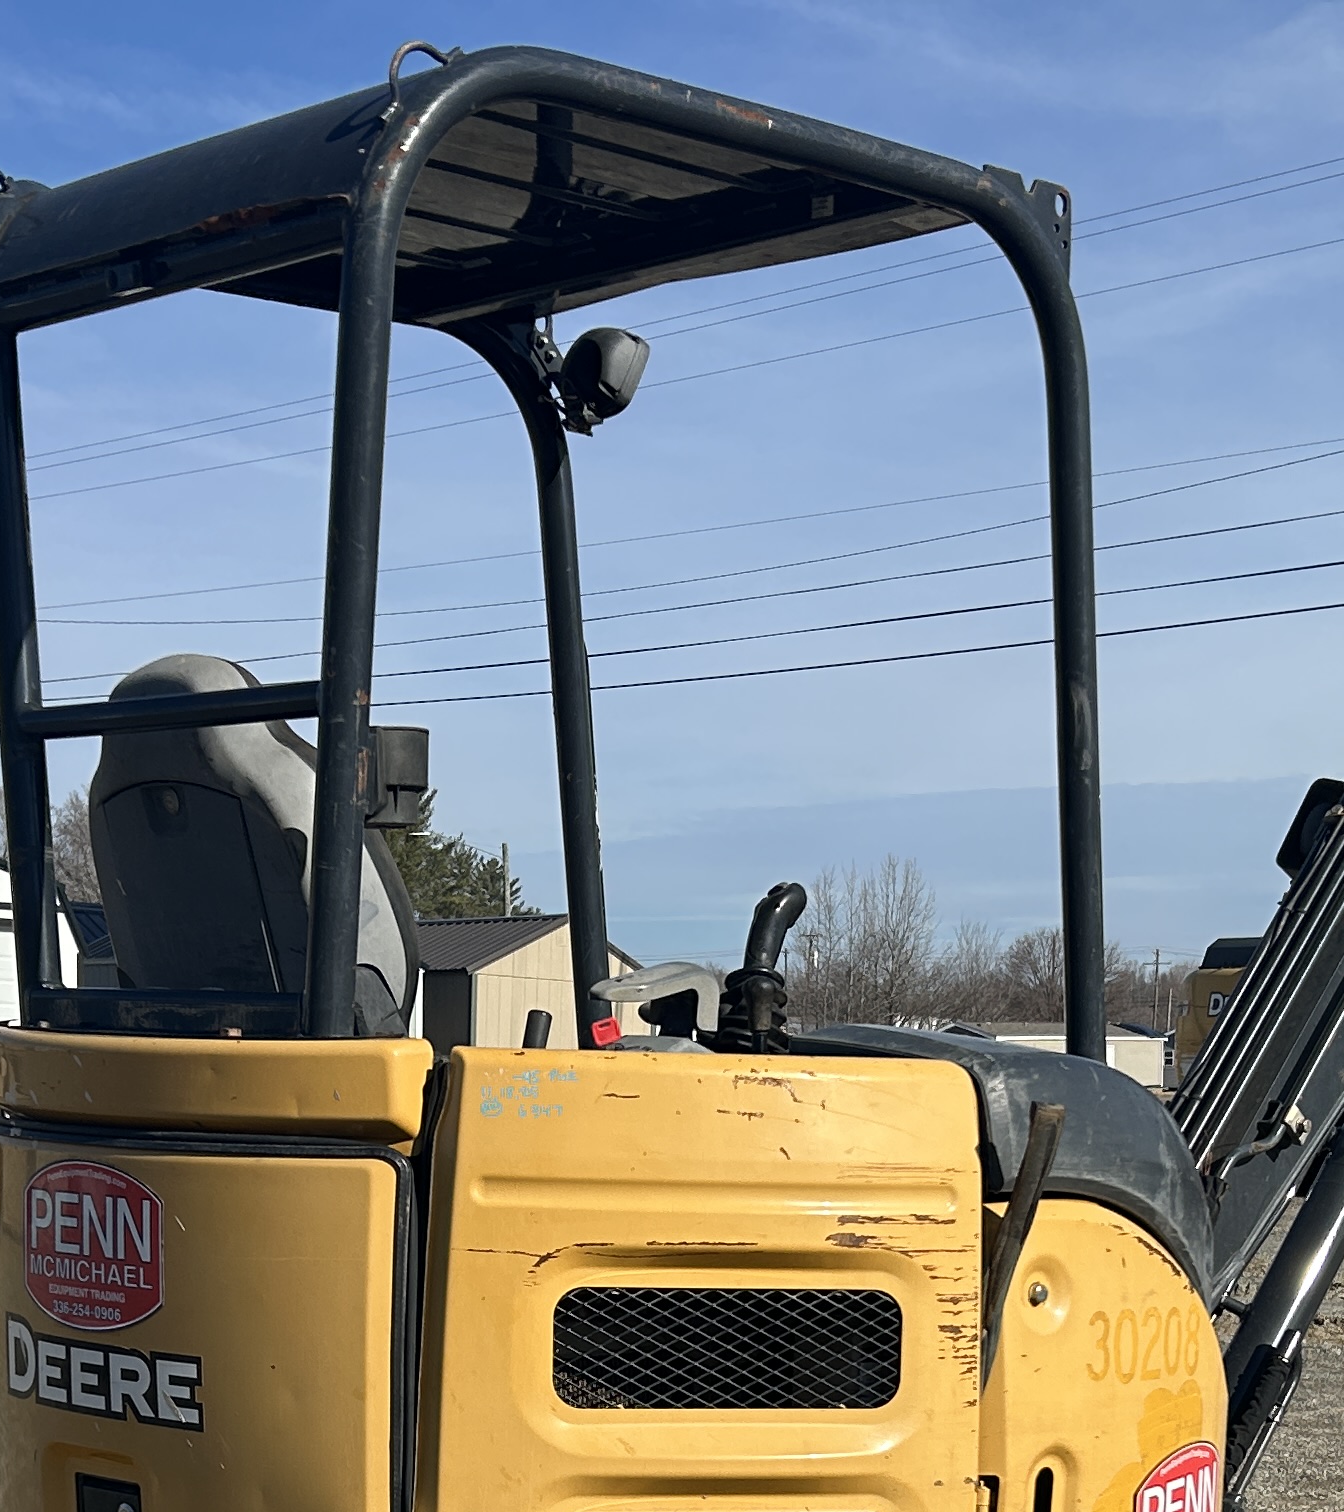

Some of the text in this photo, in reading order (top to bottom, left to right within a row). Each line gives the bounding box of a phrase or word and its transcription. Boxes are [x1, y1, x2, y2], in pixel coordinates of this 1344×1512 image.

[31, 1188, 151, 1263] PENN
[30, 1253, 154, 1290] MCMICHAEL
[90, 1289, 126, 1303] TRADING
[53, 1299, 122, 1321] 336-254-0906
[8, 1318, 200, 1425] DEERE
[1086, 1305, 1201, 1384] 30208
